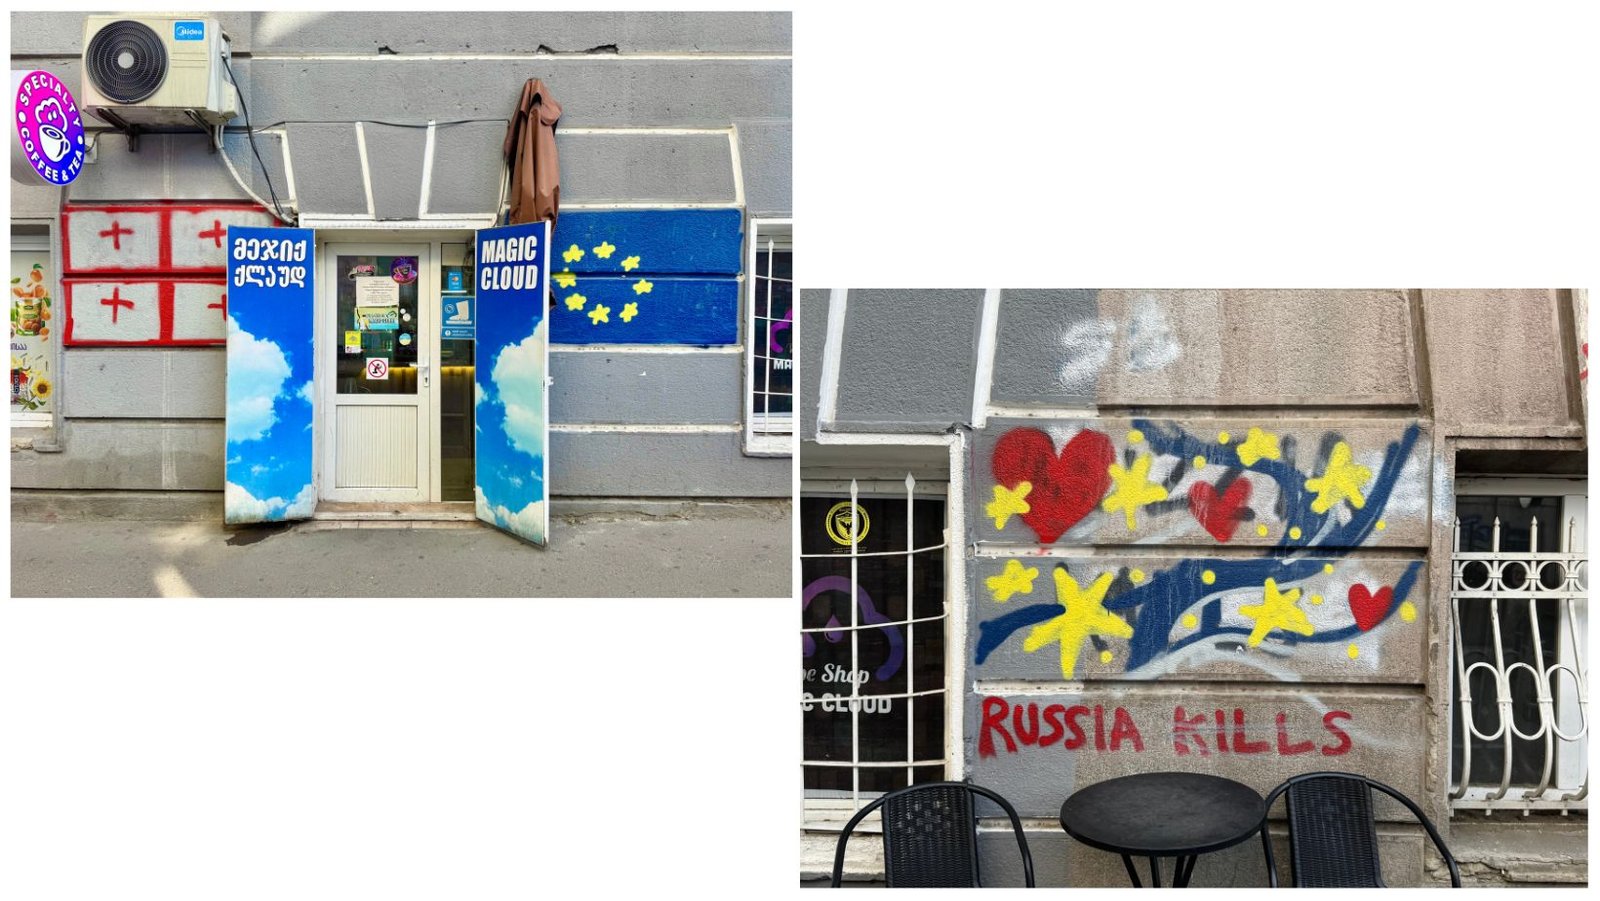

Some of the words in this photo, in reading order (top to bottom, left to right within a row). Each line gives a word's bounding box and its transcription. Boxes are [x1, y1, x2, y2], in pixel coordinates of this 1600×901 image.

[176, 26, 202, 36] Midea
[20, 74, 81, 127] SPECIALTY
[21, 127, 59, 182] COFFEE
[62, 169, 69, 181] &
[68, 150, 83, 175] TEA
[233, 237, 307, 262] მეჯიქ
[481, 235, 538, 264] MAGIC
[234, 264, 307, 288] ქლაუდ
[480, 264, 539, 291] CLOUD
[821, 663, 870, 689] Shop
[821, 692, 892, 714] CLOUD
[977, 695, 1145, 759] RUSSIA
[1172, 705, 1354, 758] KILLS
